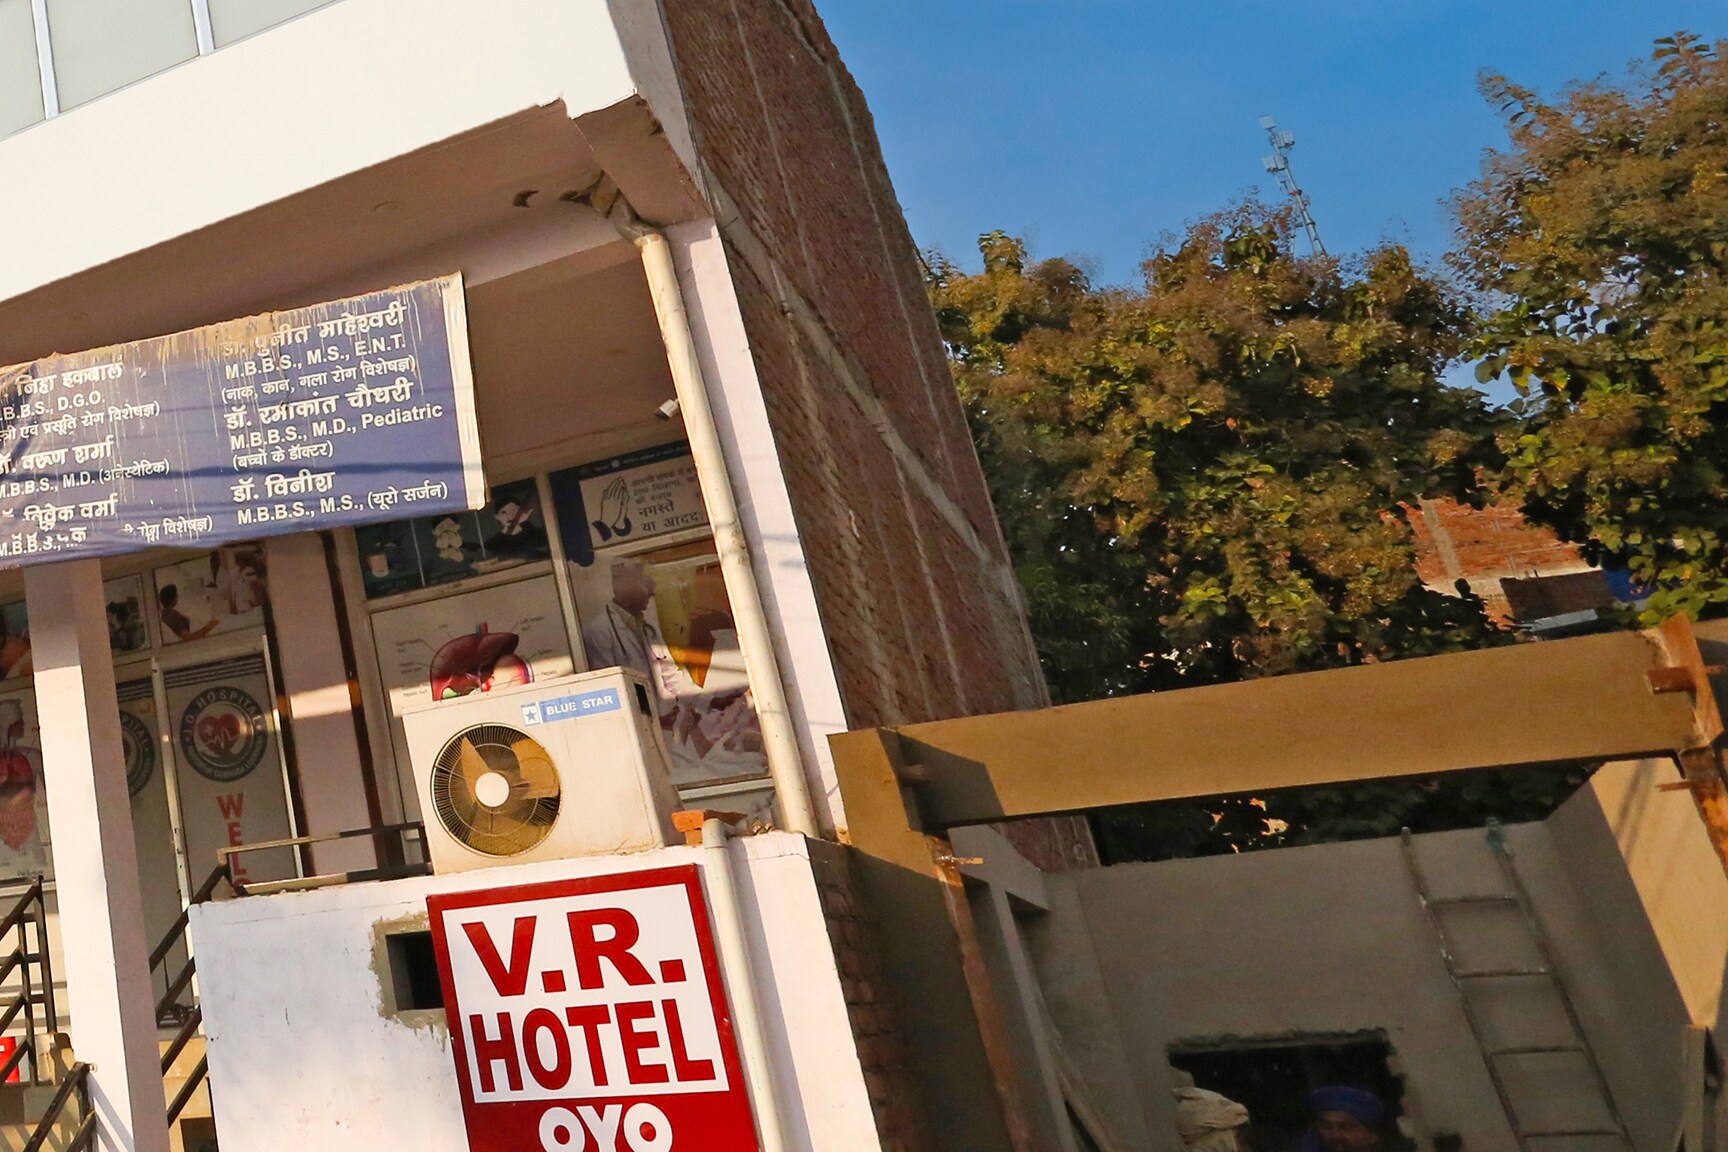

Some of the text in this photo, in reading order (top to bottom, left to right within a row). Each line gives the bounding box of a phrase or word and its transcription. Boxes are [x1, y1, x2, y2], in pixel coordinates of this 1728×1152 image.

[225, 333, 406, 380] M.B.B.S., M.S., E.N.T.
[299, 371, 327, 388] गला
[331, 365, 357, 384] रोग
[58, 391, 105, 411] D.G.O.
[224, 376, 414, 430] डॉ. रमाकांत चौधरी
[81, 410, 104, 427] रोग
[230, 403, 444, 451] M.B.B.S., M.D., Pediatric
[271, 445, 285, 463] के
[63, 471, 96, 489] M.D.
[231, 477, 259, 503] डॉ.
[237, 501, 315, 525] M.B.B.S.,
[320, 495, 364, 514] M.S.,
[546, 695, 613, 716] BLUE STAR
[461, 907, 687, 997] V.R.
[469, 998, 717, 1093] HOTEL
[538, 1102, 673, 1152] OYO
